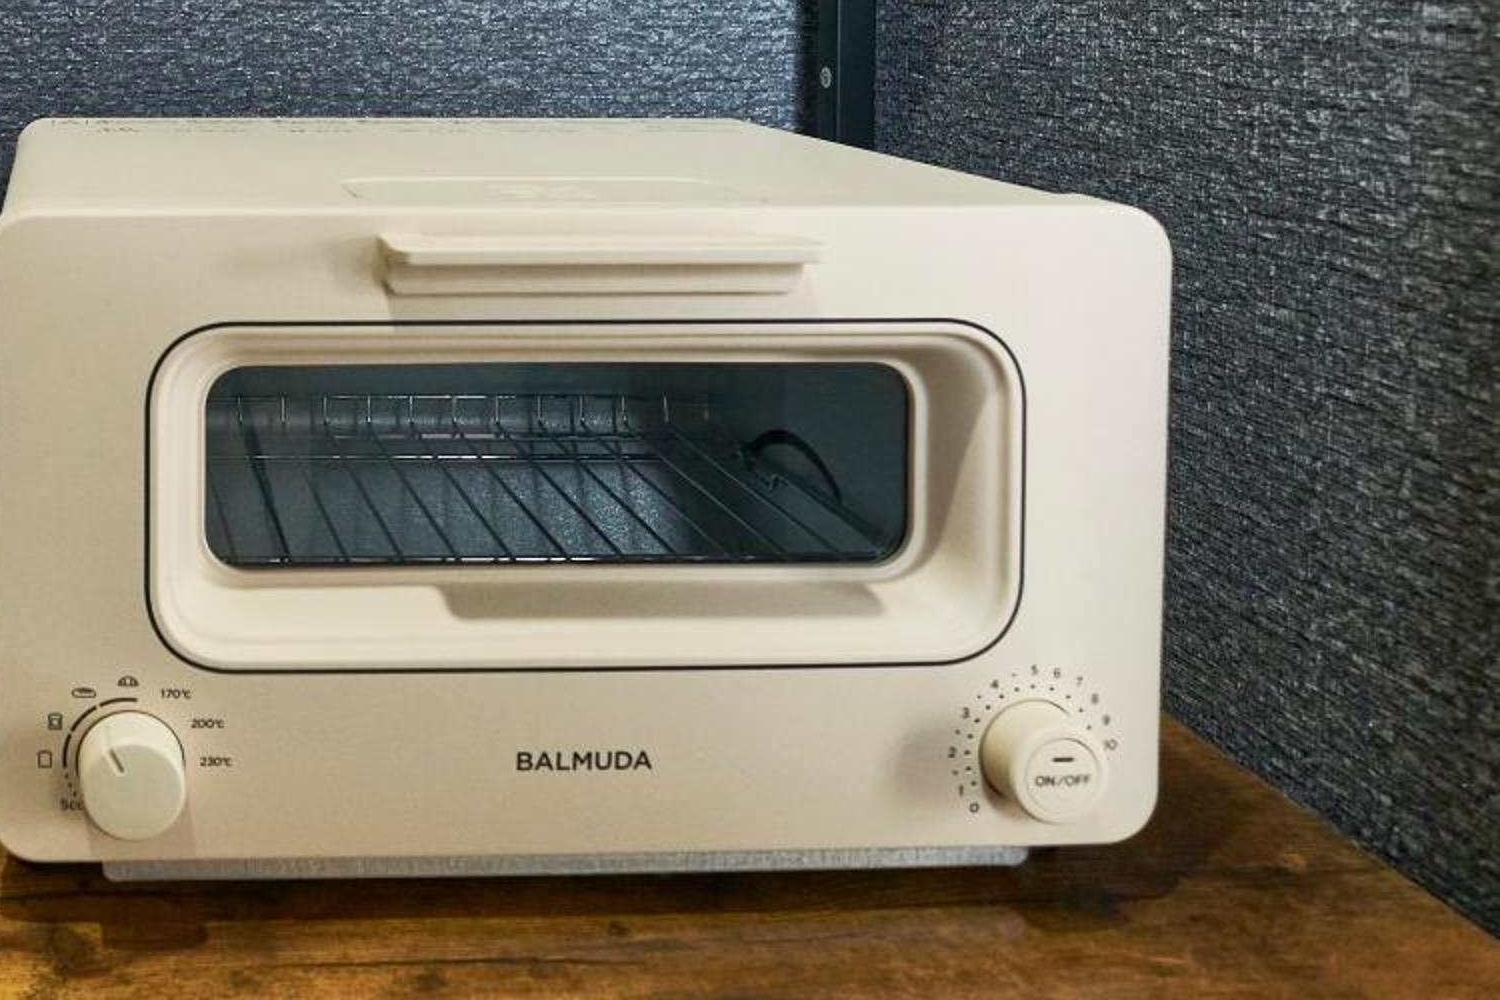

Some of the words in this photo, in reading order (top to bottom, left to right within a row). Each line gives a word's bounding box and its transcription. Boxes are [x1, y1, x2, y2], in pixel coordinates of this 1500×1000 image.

[1030, 665, 1038, 675] 5
[516, 751, 652, 771] BALMUDA
[1034, 774, 1091, 786] ON/OFF
